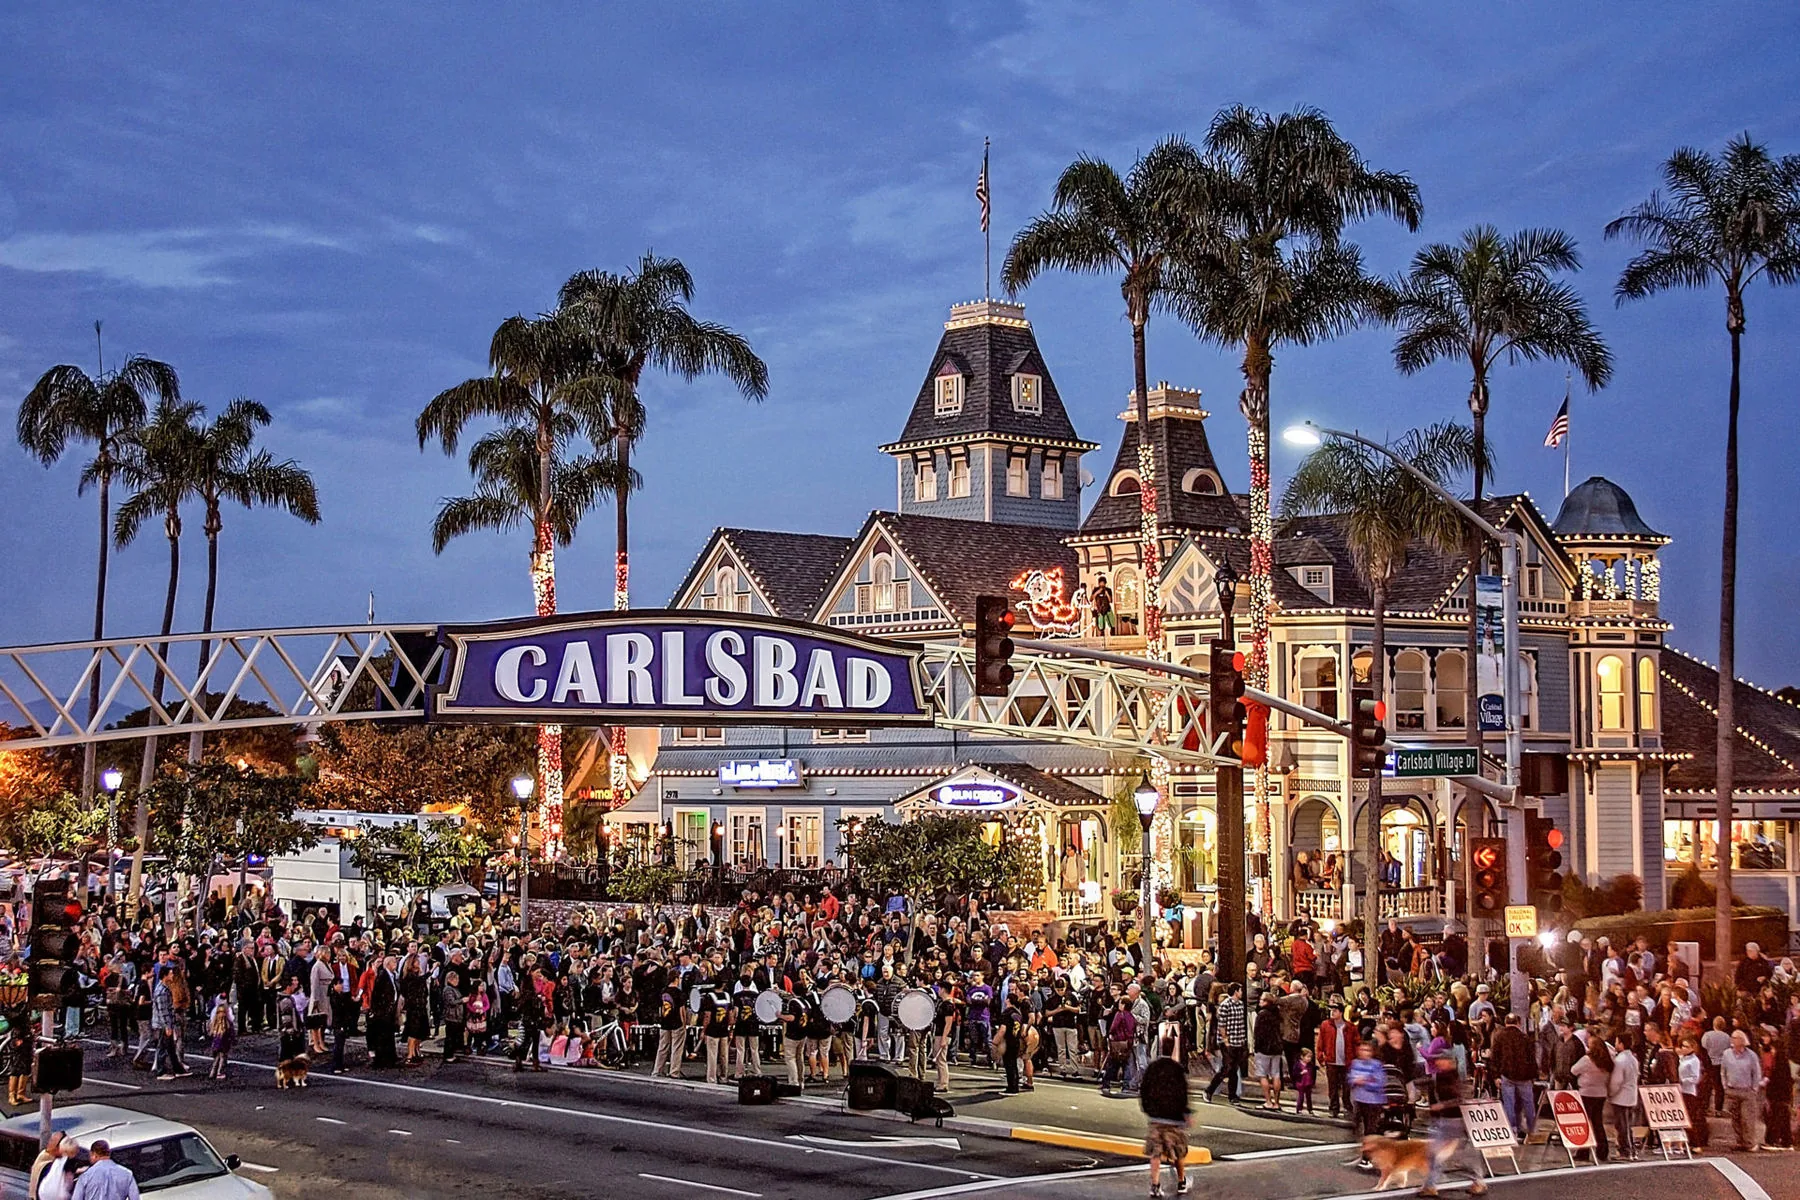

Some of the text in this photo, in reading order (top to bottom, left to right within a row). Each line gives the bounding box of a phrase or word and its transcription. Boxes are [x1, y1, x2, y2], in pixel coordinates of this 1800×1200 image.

[495, 630, 892, 709] CARLSBAD
[1480, 711, 1503, 727] Village
[1397, 754, 1433, 770] Carlsbad
[1435, 753, 1464, 773] Village
[1466, 754, 1475, 768] Dr
[1509, 923, 1522, 935] OK
[1648, 1091, 1675, 1104] ROAD
[1555, 1101, 1579, 1112] DO NOT
[1468, 1108, 1499, 1123] ROAD
[1649, 1109, 1685, 1123] CLOSED
[1471, 1127, 1511, 1142] CLOSED
[1565, 1125, 1585, 1136] ENTER
